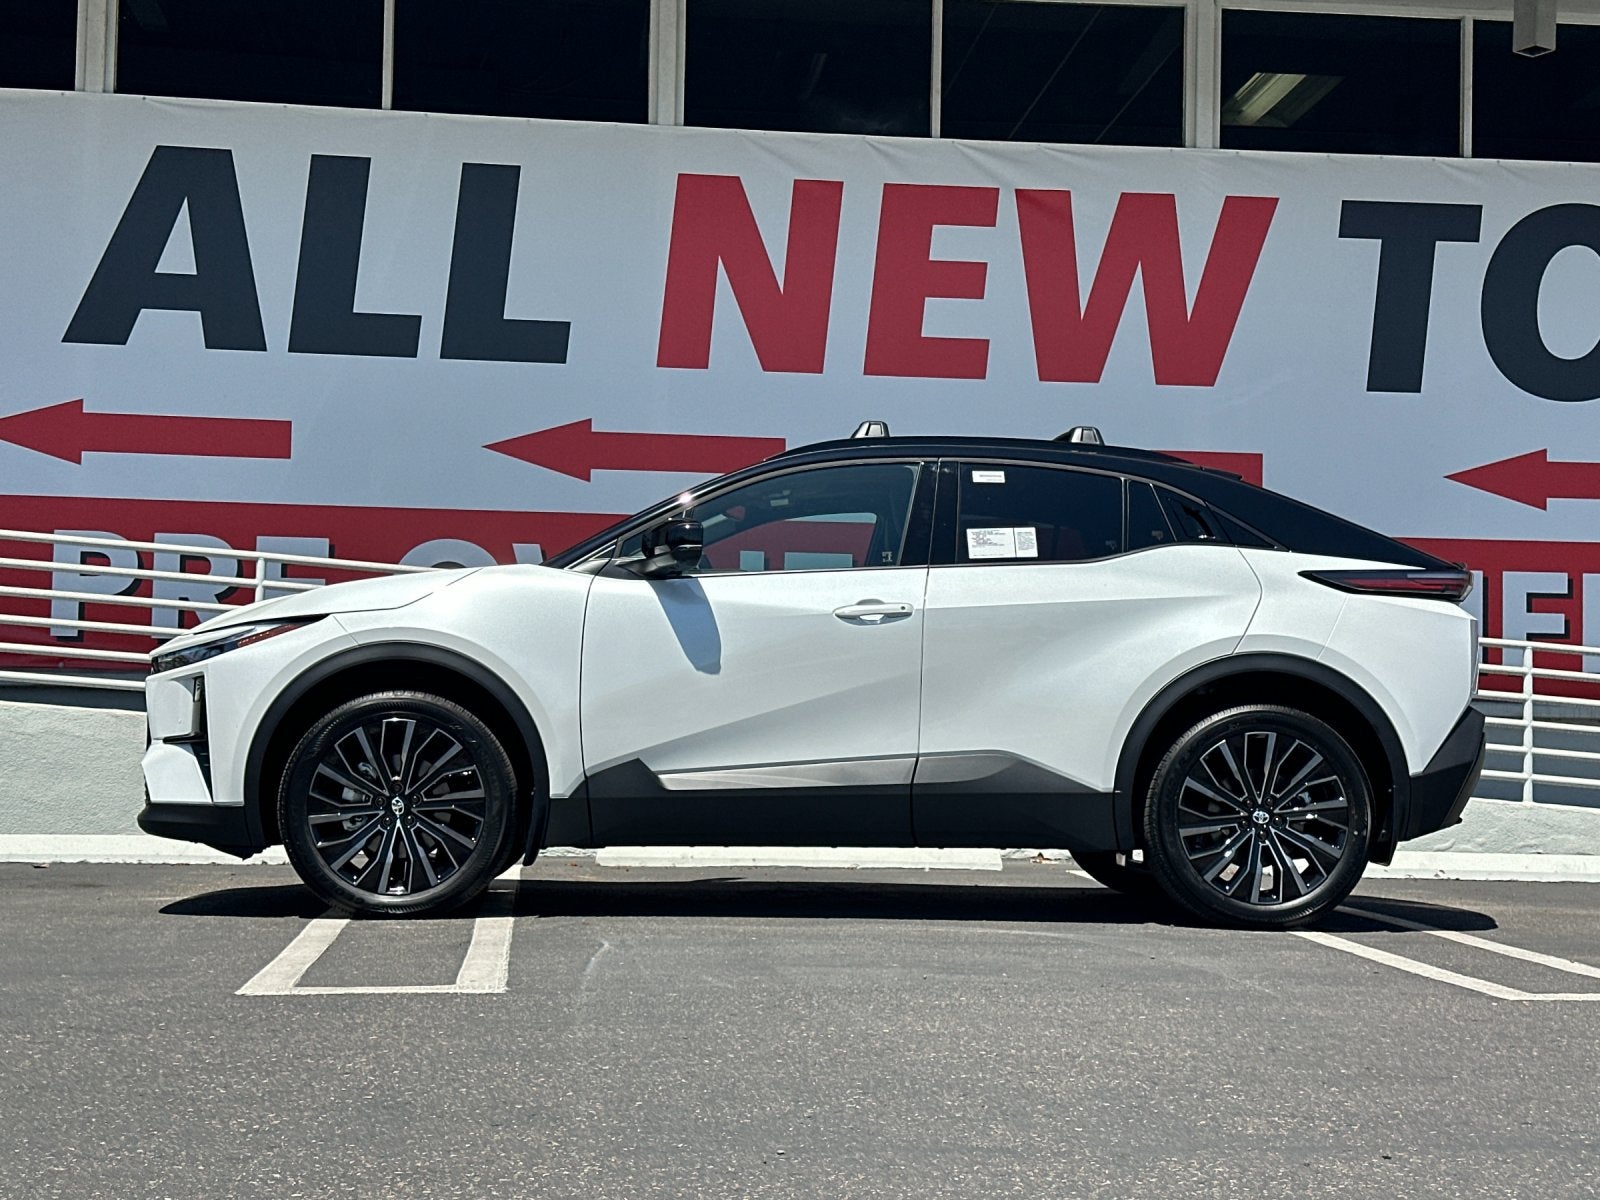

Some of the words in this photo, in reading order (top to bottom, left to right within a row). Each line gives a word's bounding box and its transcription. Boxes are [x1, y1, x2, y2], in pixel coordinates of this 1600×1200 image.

[61, 144, 572, 365] ALL
[656, 172, 1281, 388] NEW
[1338, 199, 1600, 403] TO
